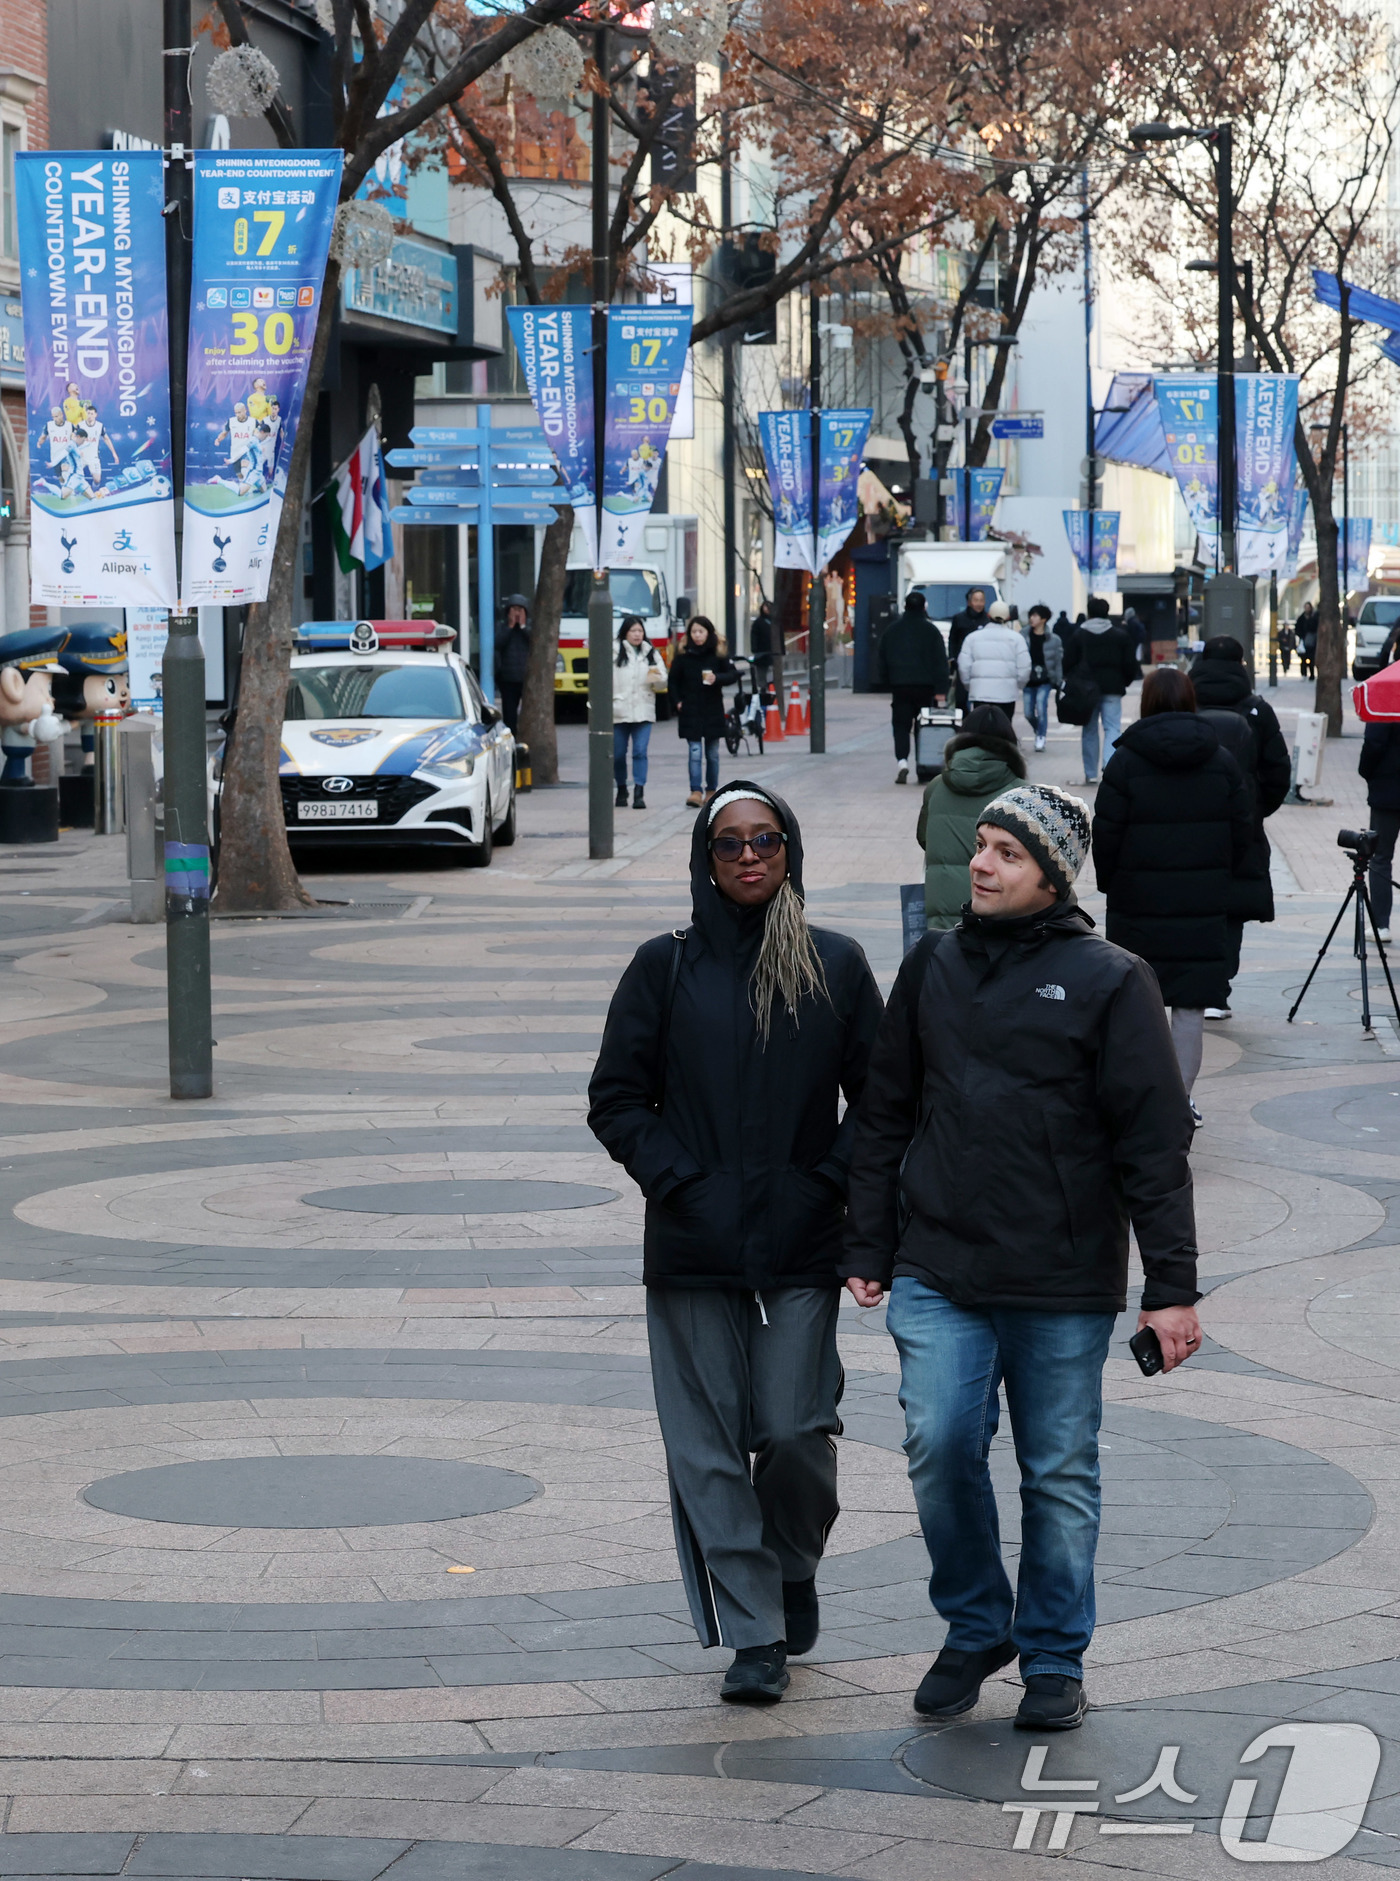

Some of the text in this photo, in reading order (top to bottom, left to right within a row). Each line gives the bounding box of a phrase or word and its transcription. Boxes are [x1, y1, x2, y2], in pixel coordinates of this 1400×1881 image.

[200, 169, 336, 178] YEAR-END COUNTDOWN EVENT
[216, 159, 320, 167] SHINING MYEONGDONG
[243, 190, 316, 205] 支付宝活动
[254, 210, 285, 256] 7
[45, 162, 70, 380] COUNTDOWN EVENT
[71, 162, 110, 379] YEAR-END
[112, 161, 137, 417] SHINING MYEONGDONG
[204, 347, 226, 356] Enjoy
[206, 358, 226, 366] after
[228, 357, 264, 368] claiming
[266, 357, 280, 366] the
[523, 311, 539, 397] COUNTDOWN
[642, 339, 661, 366] 7
[538, 311, 563, 437] YEAR-END
[561, 311, 578, 458] SHINING MYEONGDONG
[629, 397, 667, 423] 30
[776, 413, 795, 491] YEAR-END
[841, 430, 854, 447] 7
[339, 803, 372, 816] 7416
